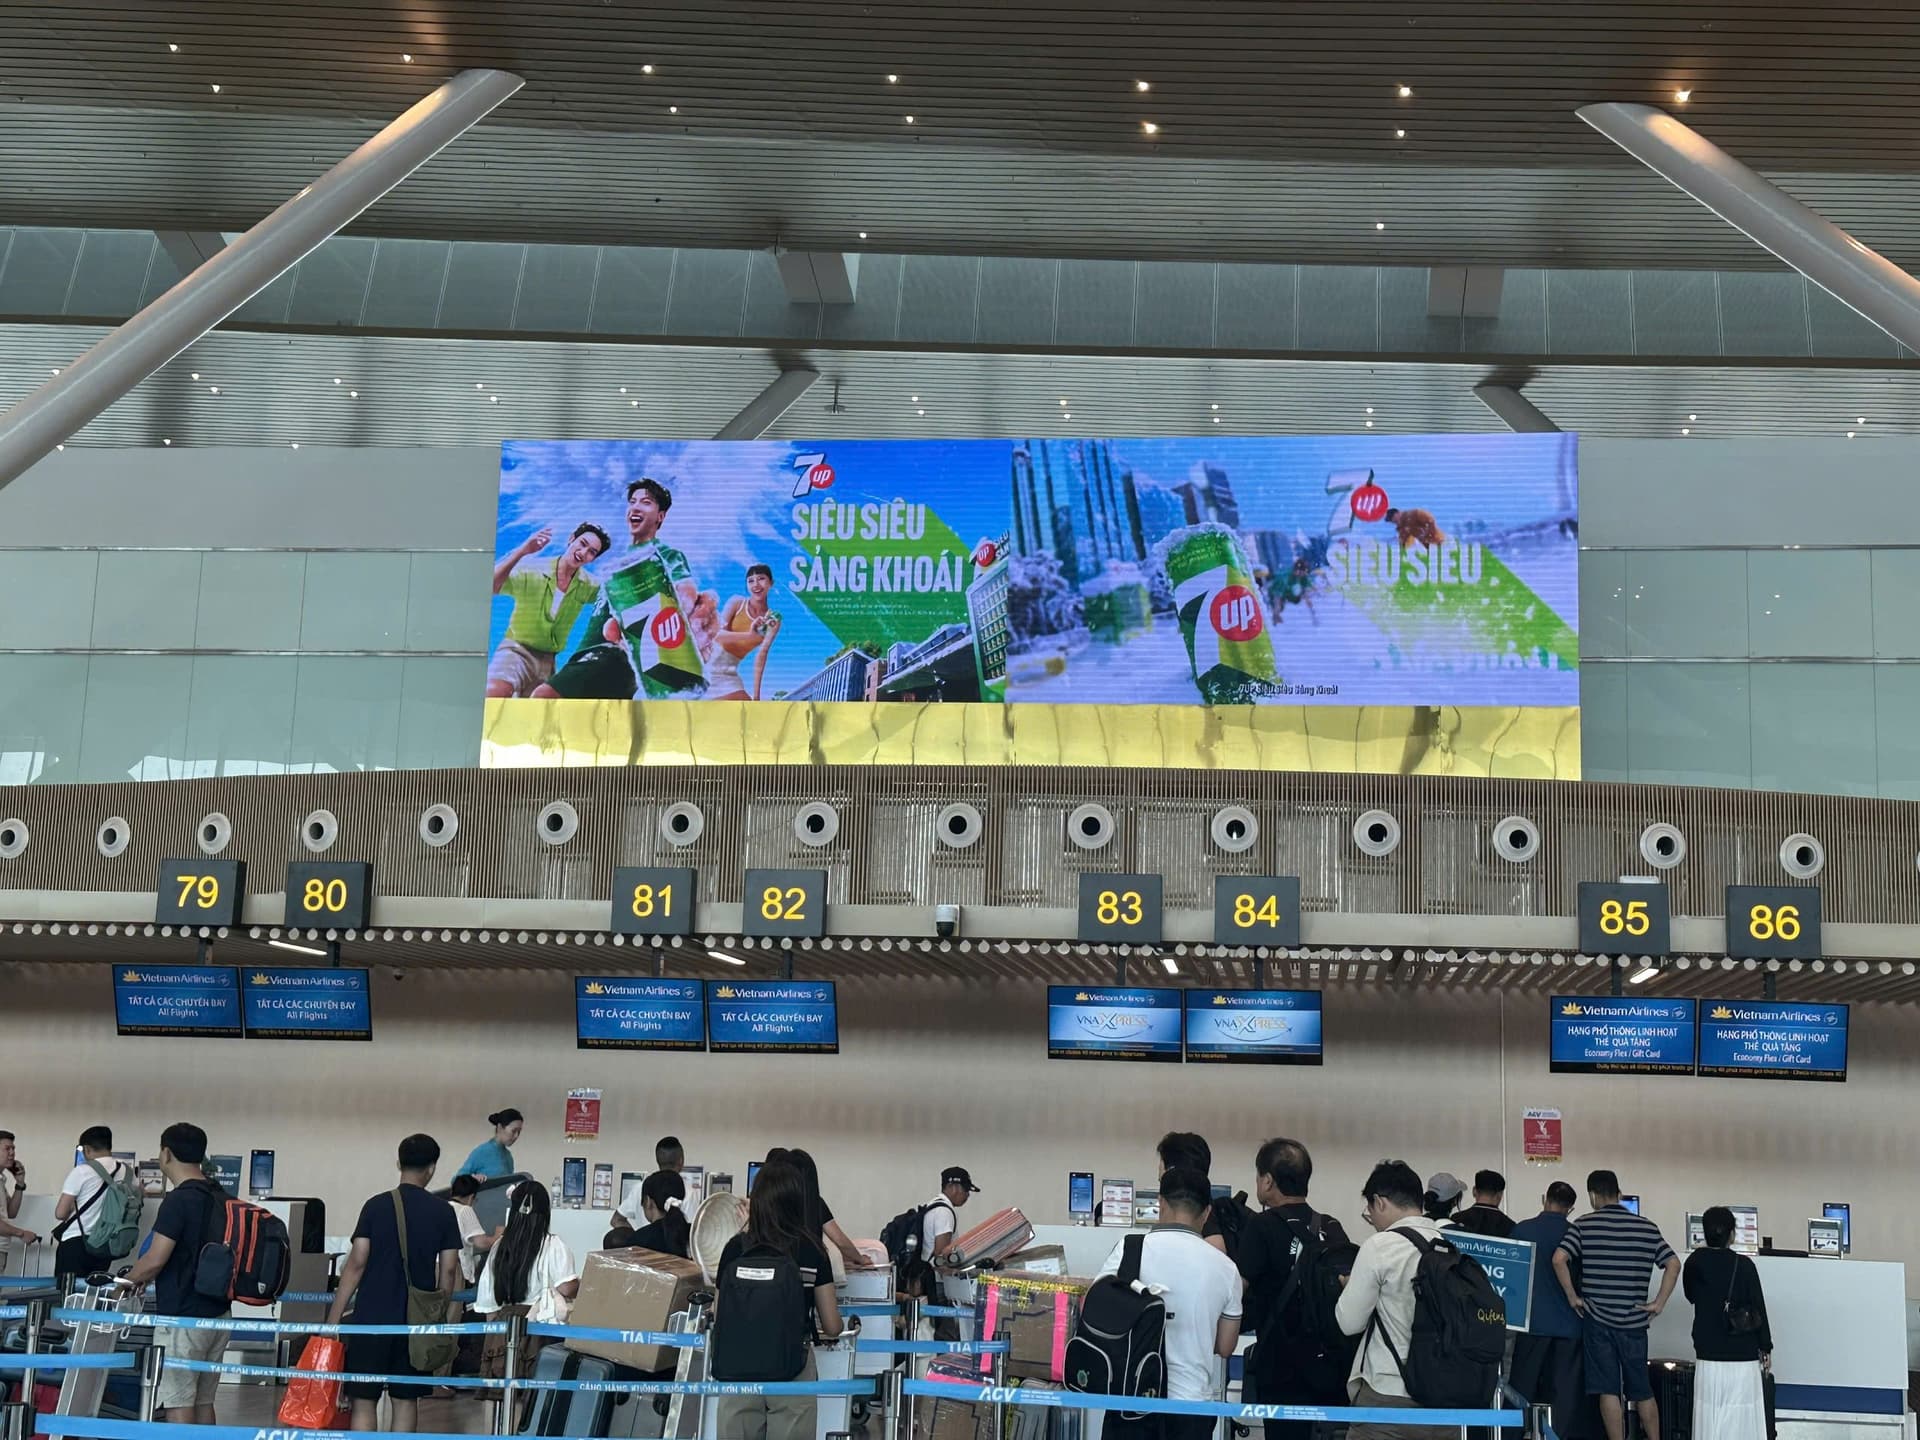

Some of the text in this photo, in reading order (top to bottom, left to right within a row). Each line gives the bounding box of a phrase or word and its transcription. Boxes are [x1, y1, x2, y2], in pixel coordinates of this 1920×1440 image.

[791, 496, 926, 540] SIÊU SIÊU
[788, 544, 963, 592] SẢNG KHOÁI
[176, 875, 219, 909] 79
[303, 878, 348, 912] 80
[632, 884, 672, 917] 81
[761, 887, 806, 920] 82
[1096, 890, 1144, 925] 83
[1233, 893, 1280, 928] 84
[1600, 900, 1650, 936] 85
[1749, 904, 1801, 941] 86
[340, 1002, 356, 1010] BAY
[1583, 1006, 1668, 1016] Vietnam Airlines
[674, 1012, 691, 1020] BAY
[1732, 1009, 1820, 1022] Vietnam Airlines
[1638, 1028, 1656, 1036] LINH
[1788, 1032, 1806, 1041] LINH
[1585, 1049, 1614, 1059] Economy
[1614, 1049, 1627, 1057] Flex
[1632, 1050, 1644, 1058] Gift
[1646, 1050, 1660, 1058] Card
[1734, 1052, 1762, 1063] Economy
[1764, 1053, 1777, 1062] Flex
[1782, 1054, 1795, 1063] Gift
[1796, 1055, 1812, 1064] Card
[1473, 1242, 1506, 1256] Airlines
[122, 1313, 150, 1325] TIA
[408, 1326, 438, 1334] TIA
[620, 1330, 644, 1344] TIA
[948, 1342, 970, 1352] TIA
[978, 1388, 1016, 1401] ACV
[1240, 1404, 1280, 1418] ACV
